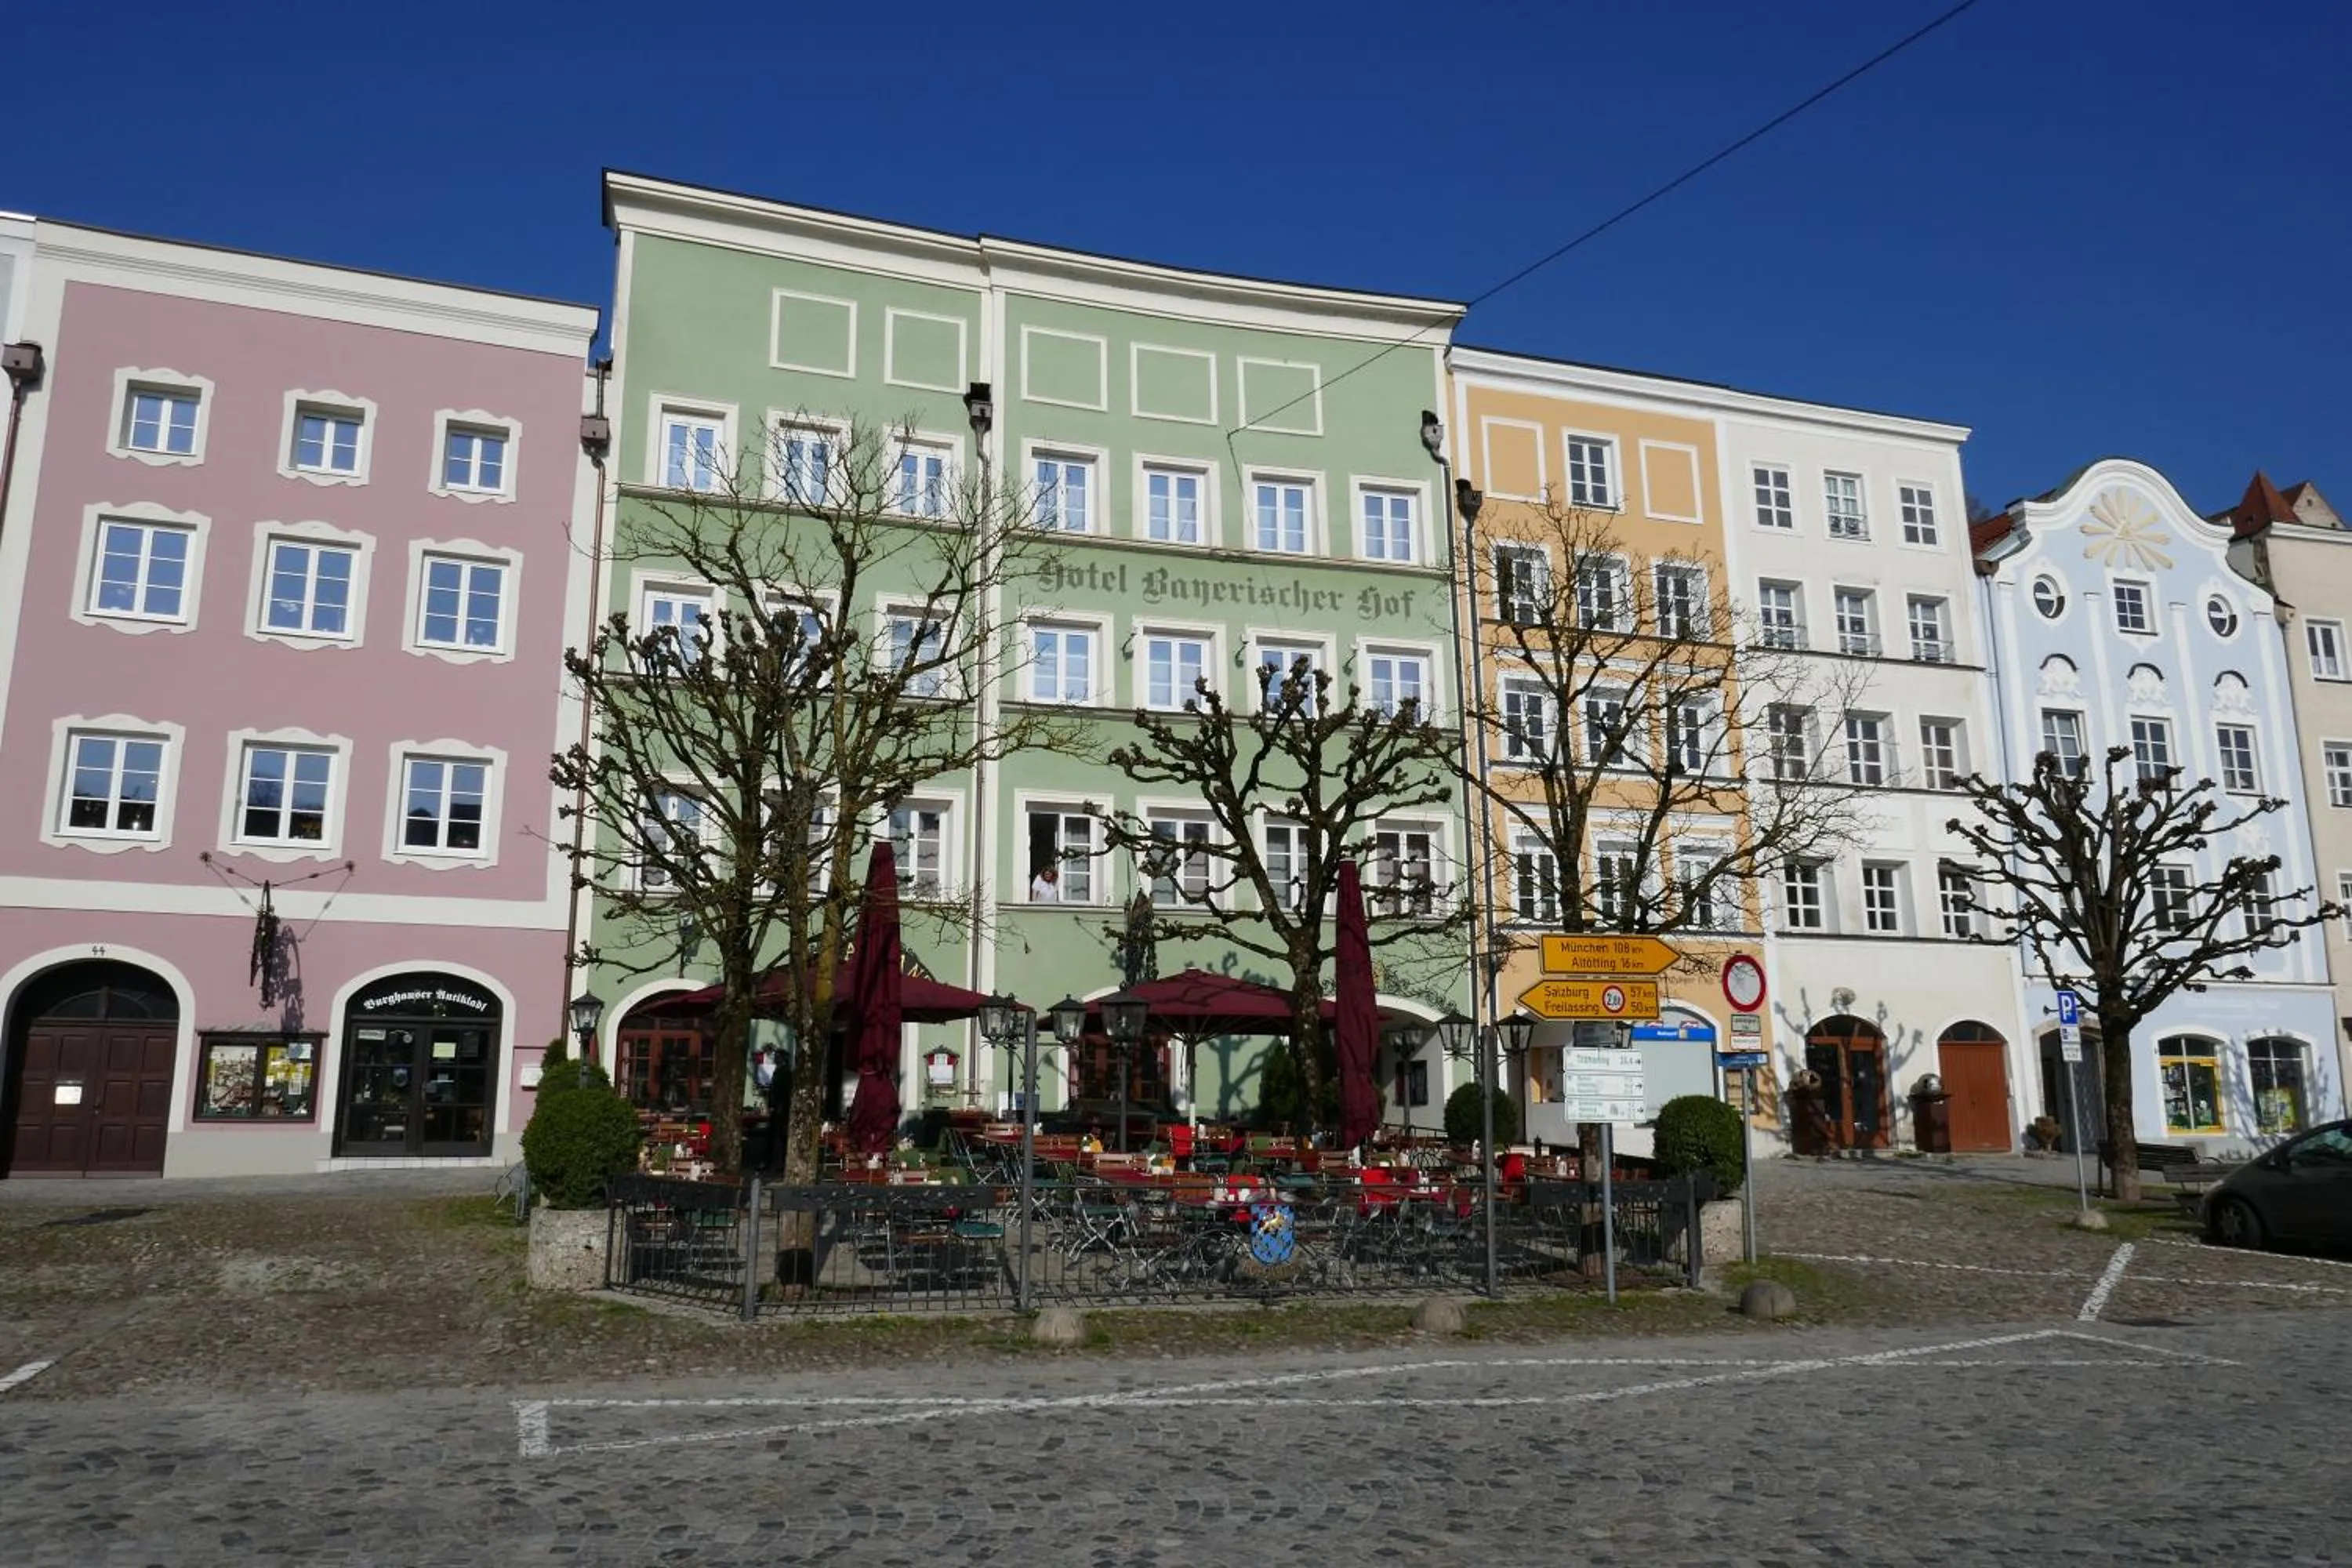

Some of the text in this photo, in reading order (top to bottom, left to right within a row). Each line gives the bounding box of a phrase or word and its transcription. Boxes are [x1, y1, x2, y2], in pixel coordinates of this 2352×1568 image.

[1037, 560, 1416, 622] Hotel Bayerischer Hof
[1561, 942, 1609, 954] München
[1613, 942, 1630, 954] 108
[1621, 958, 1631, 969] 16
[1544, 985, 1589, 1000] Salzburg
[1544, 1001, 1600, 1015] Freilassing
